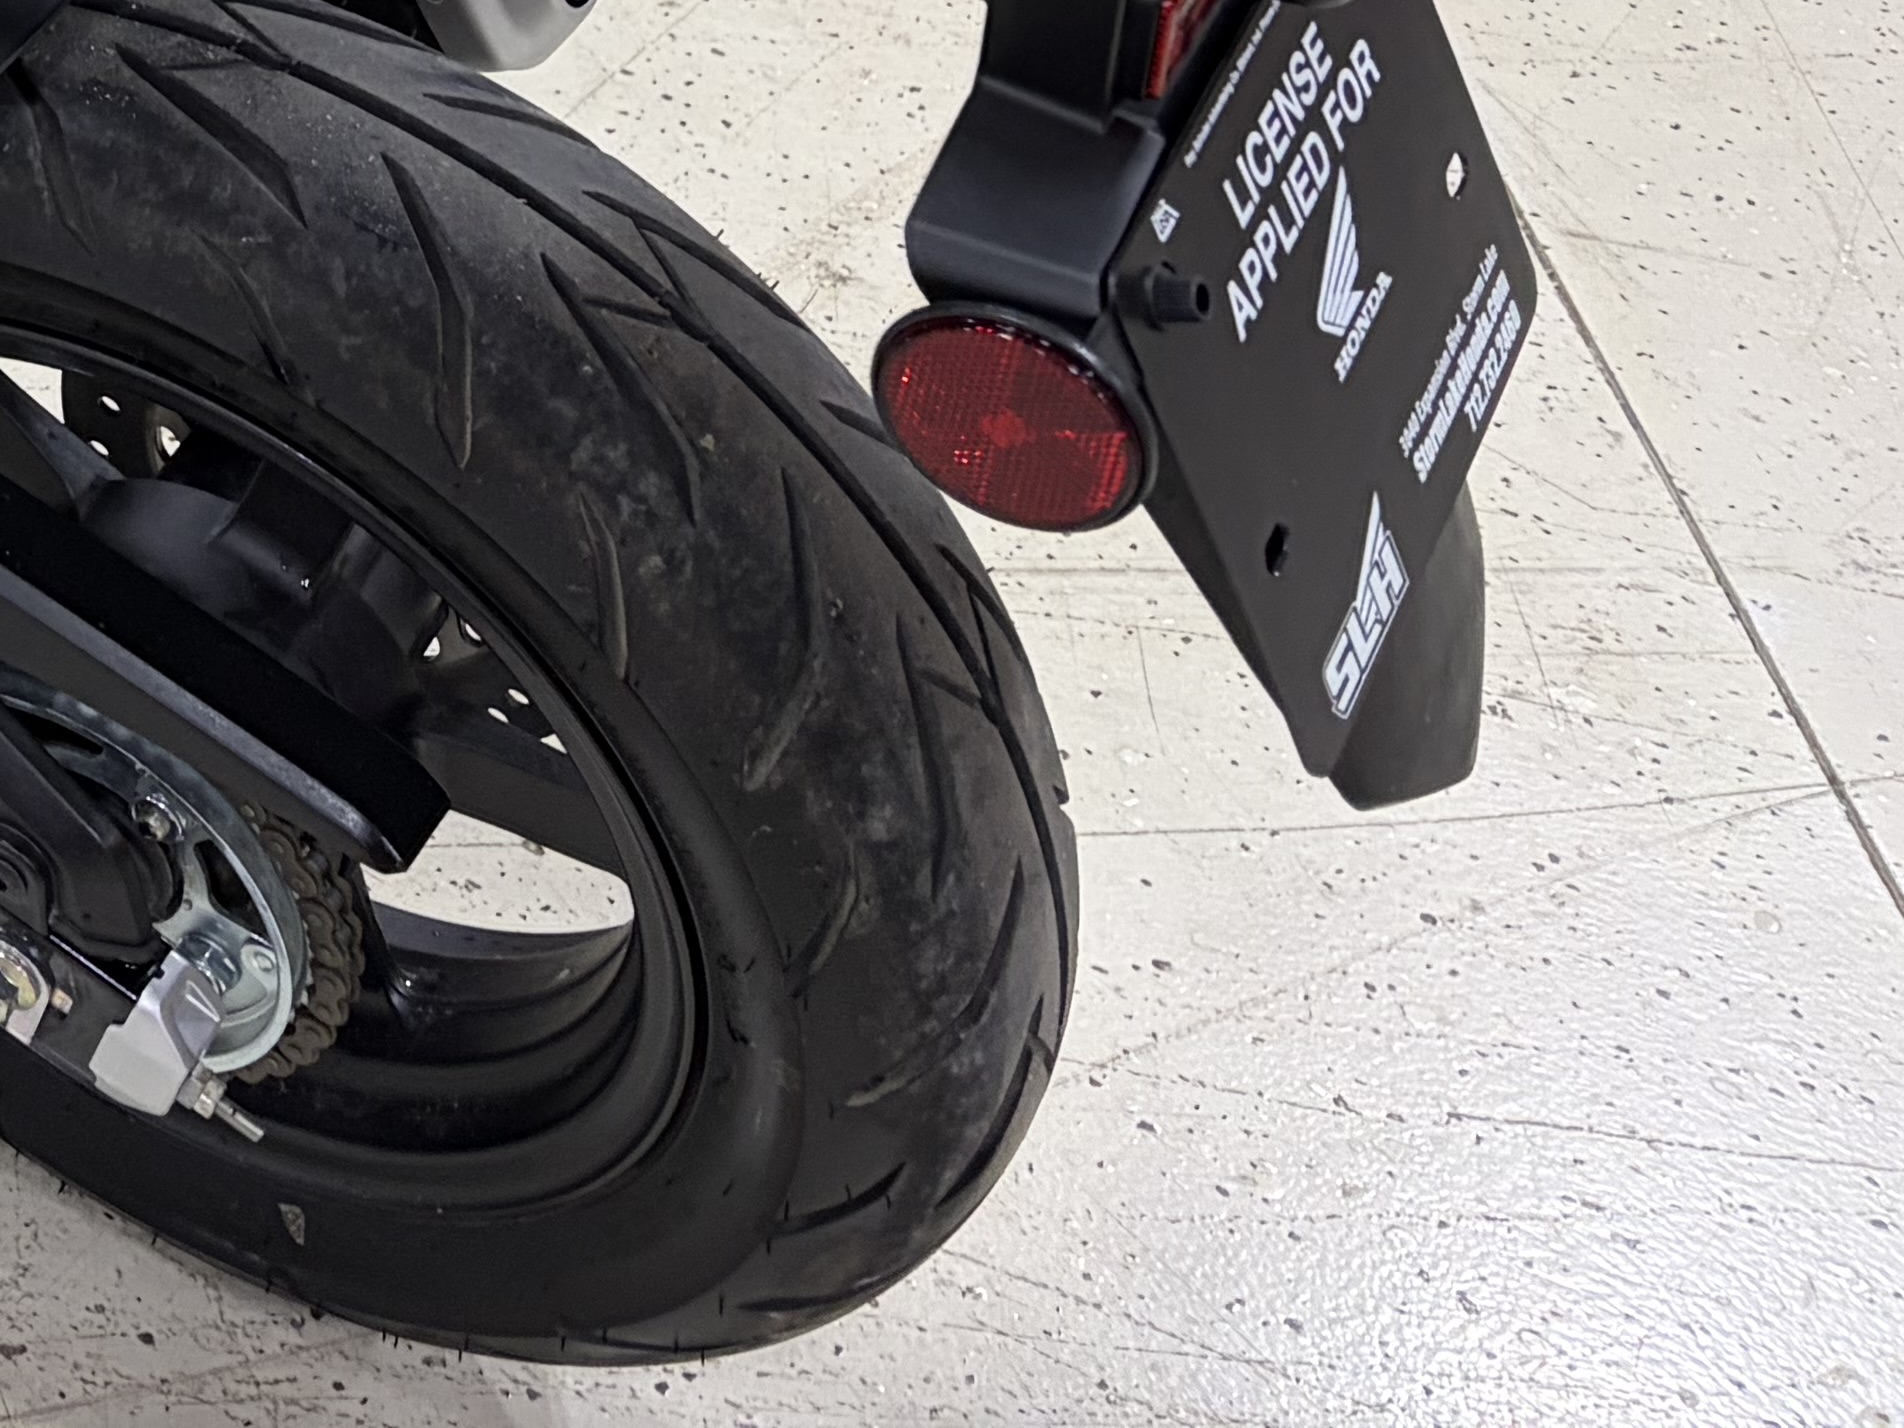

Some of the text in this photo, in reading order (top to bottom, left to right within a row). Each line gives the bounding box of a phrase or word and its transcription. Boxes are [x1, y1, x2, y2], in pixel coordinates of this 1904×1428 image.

[1222, 21, 1333, 230] LICENSE
[1226, 130, 1331, 343] APPLIED
[1321, 38, 1381, 152] FOR
[1333, 271, 1393, 383] HONDA
[1479, 244, 1498, 281] Lake
[1413, 269, 1510, 484] StormLakeHonda.com
[1322, 531, 1409, 719] SLH
